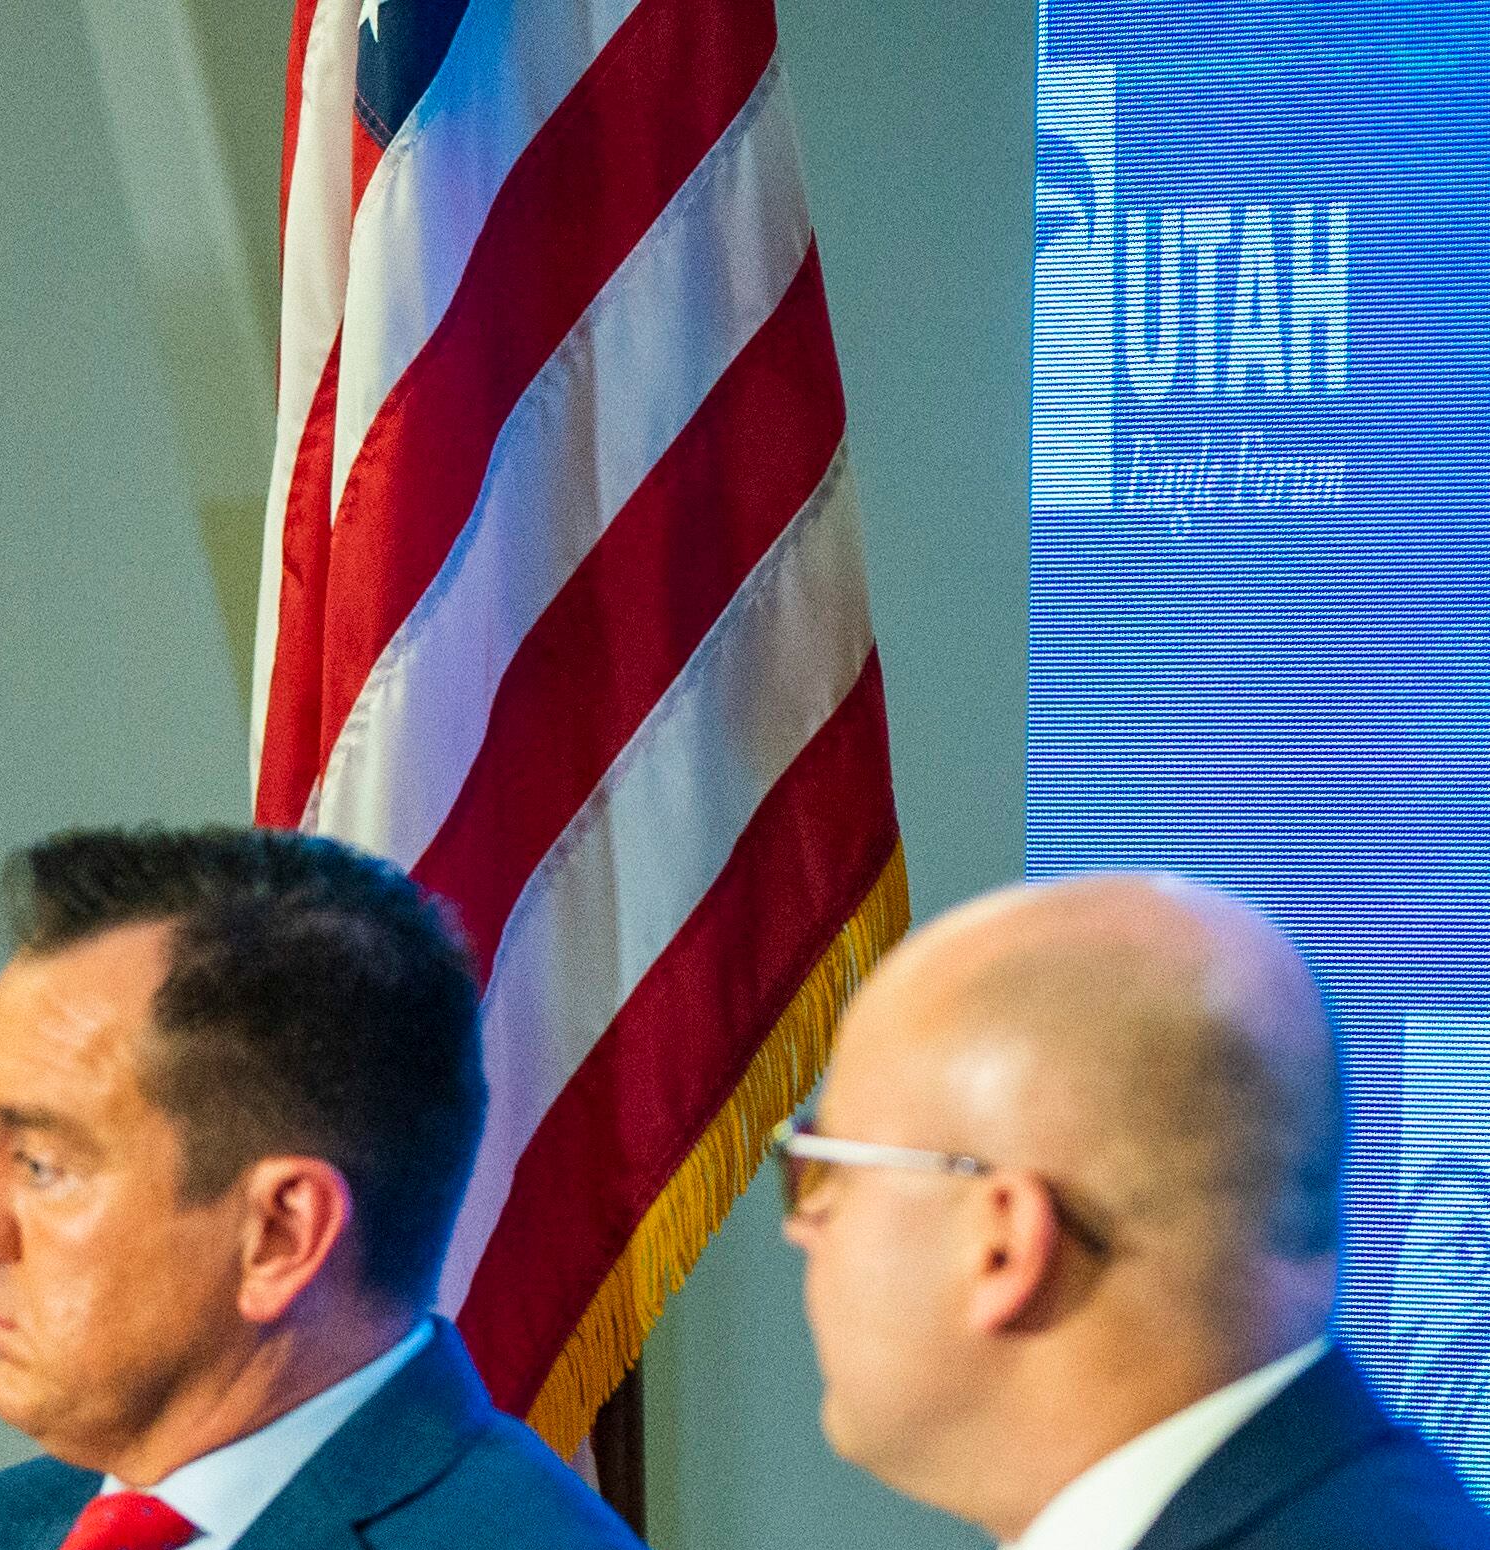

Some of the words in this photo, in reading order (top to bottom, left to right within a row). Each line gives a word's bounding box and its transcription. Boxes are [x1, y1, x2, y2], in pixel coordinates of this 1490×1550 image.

[1124, 201, 1351, 402] UTAH
[1124, 431, 1221, 539] Eagle
[1229, 430, 1347, 508] Forum
